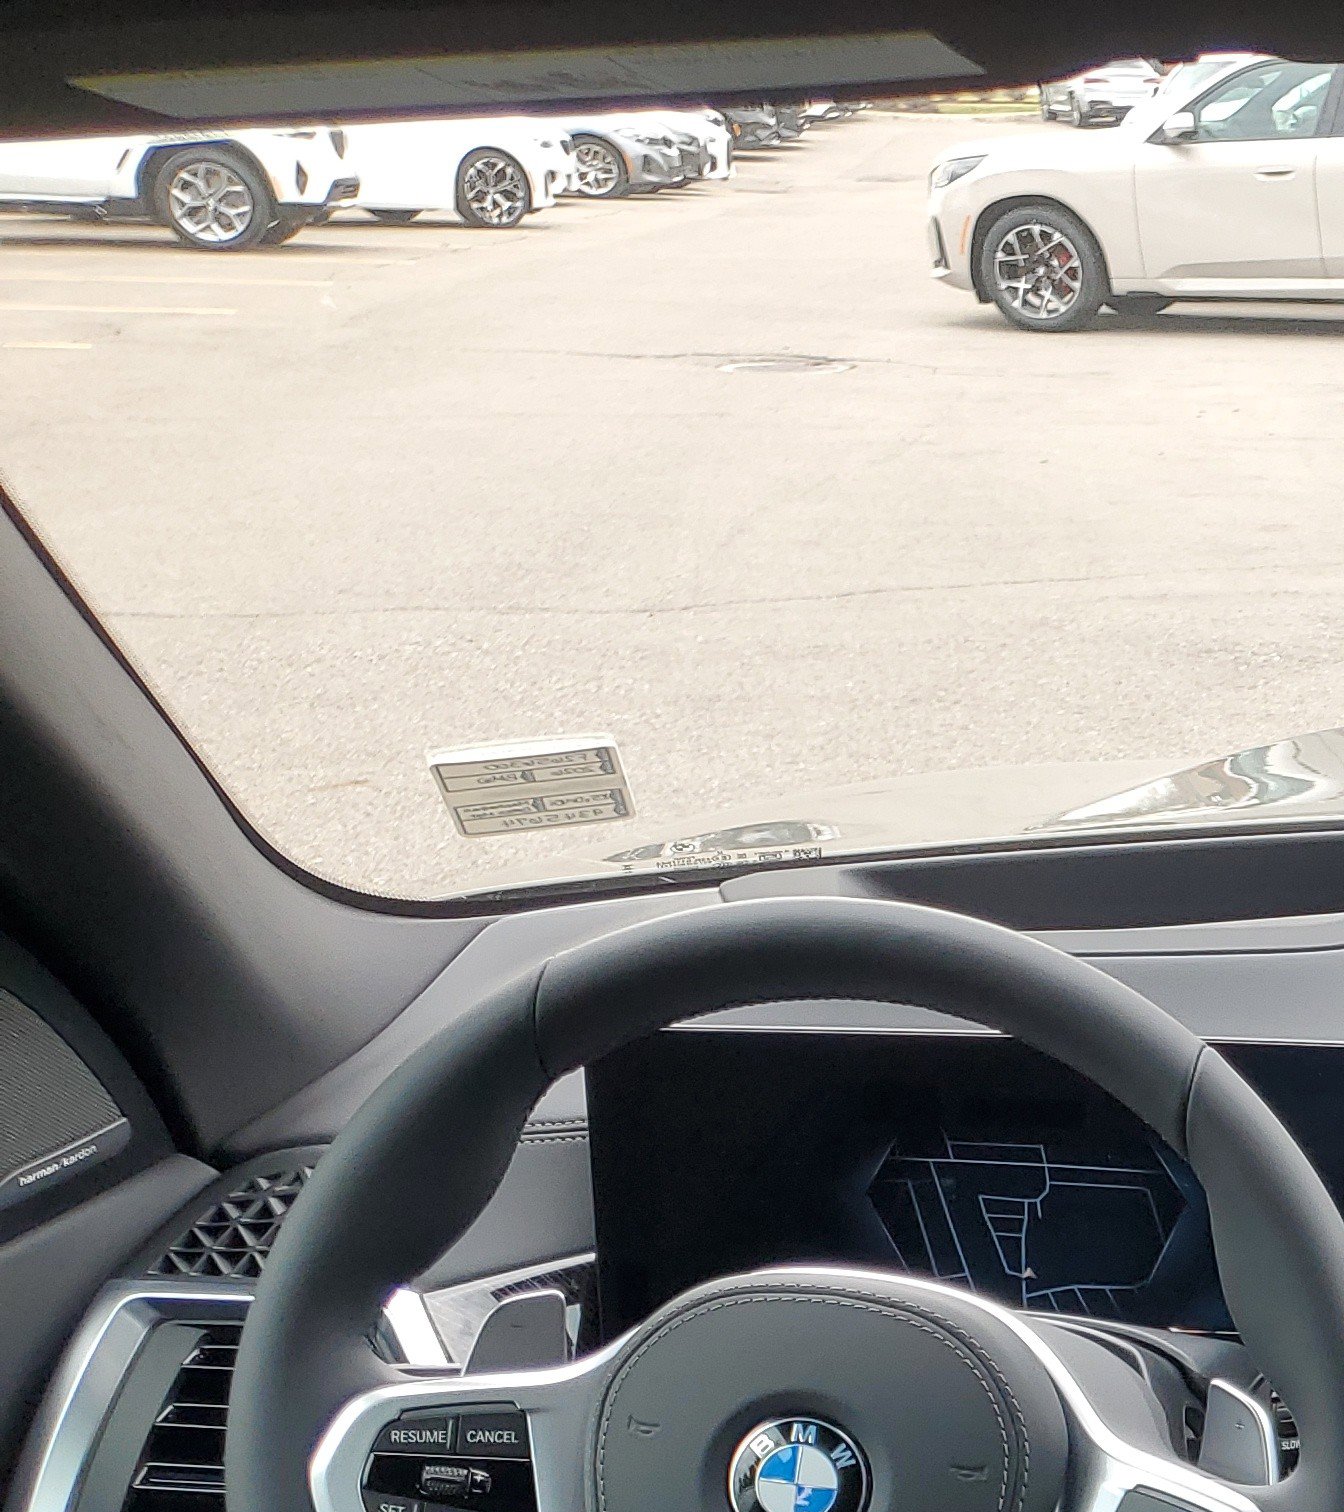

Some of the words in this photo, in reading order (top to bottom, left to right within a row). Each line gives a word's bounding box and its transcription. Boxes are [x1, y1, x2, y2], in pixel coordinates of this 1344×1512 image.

[390, 1429, 448, 1443] RESUME
[466, 1430, 519, 1443] CANCEL
[749, 1422, 857, 1470] BMW
